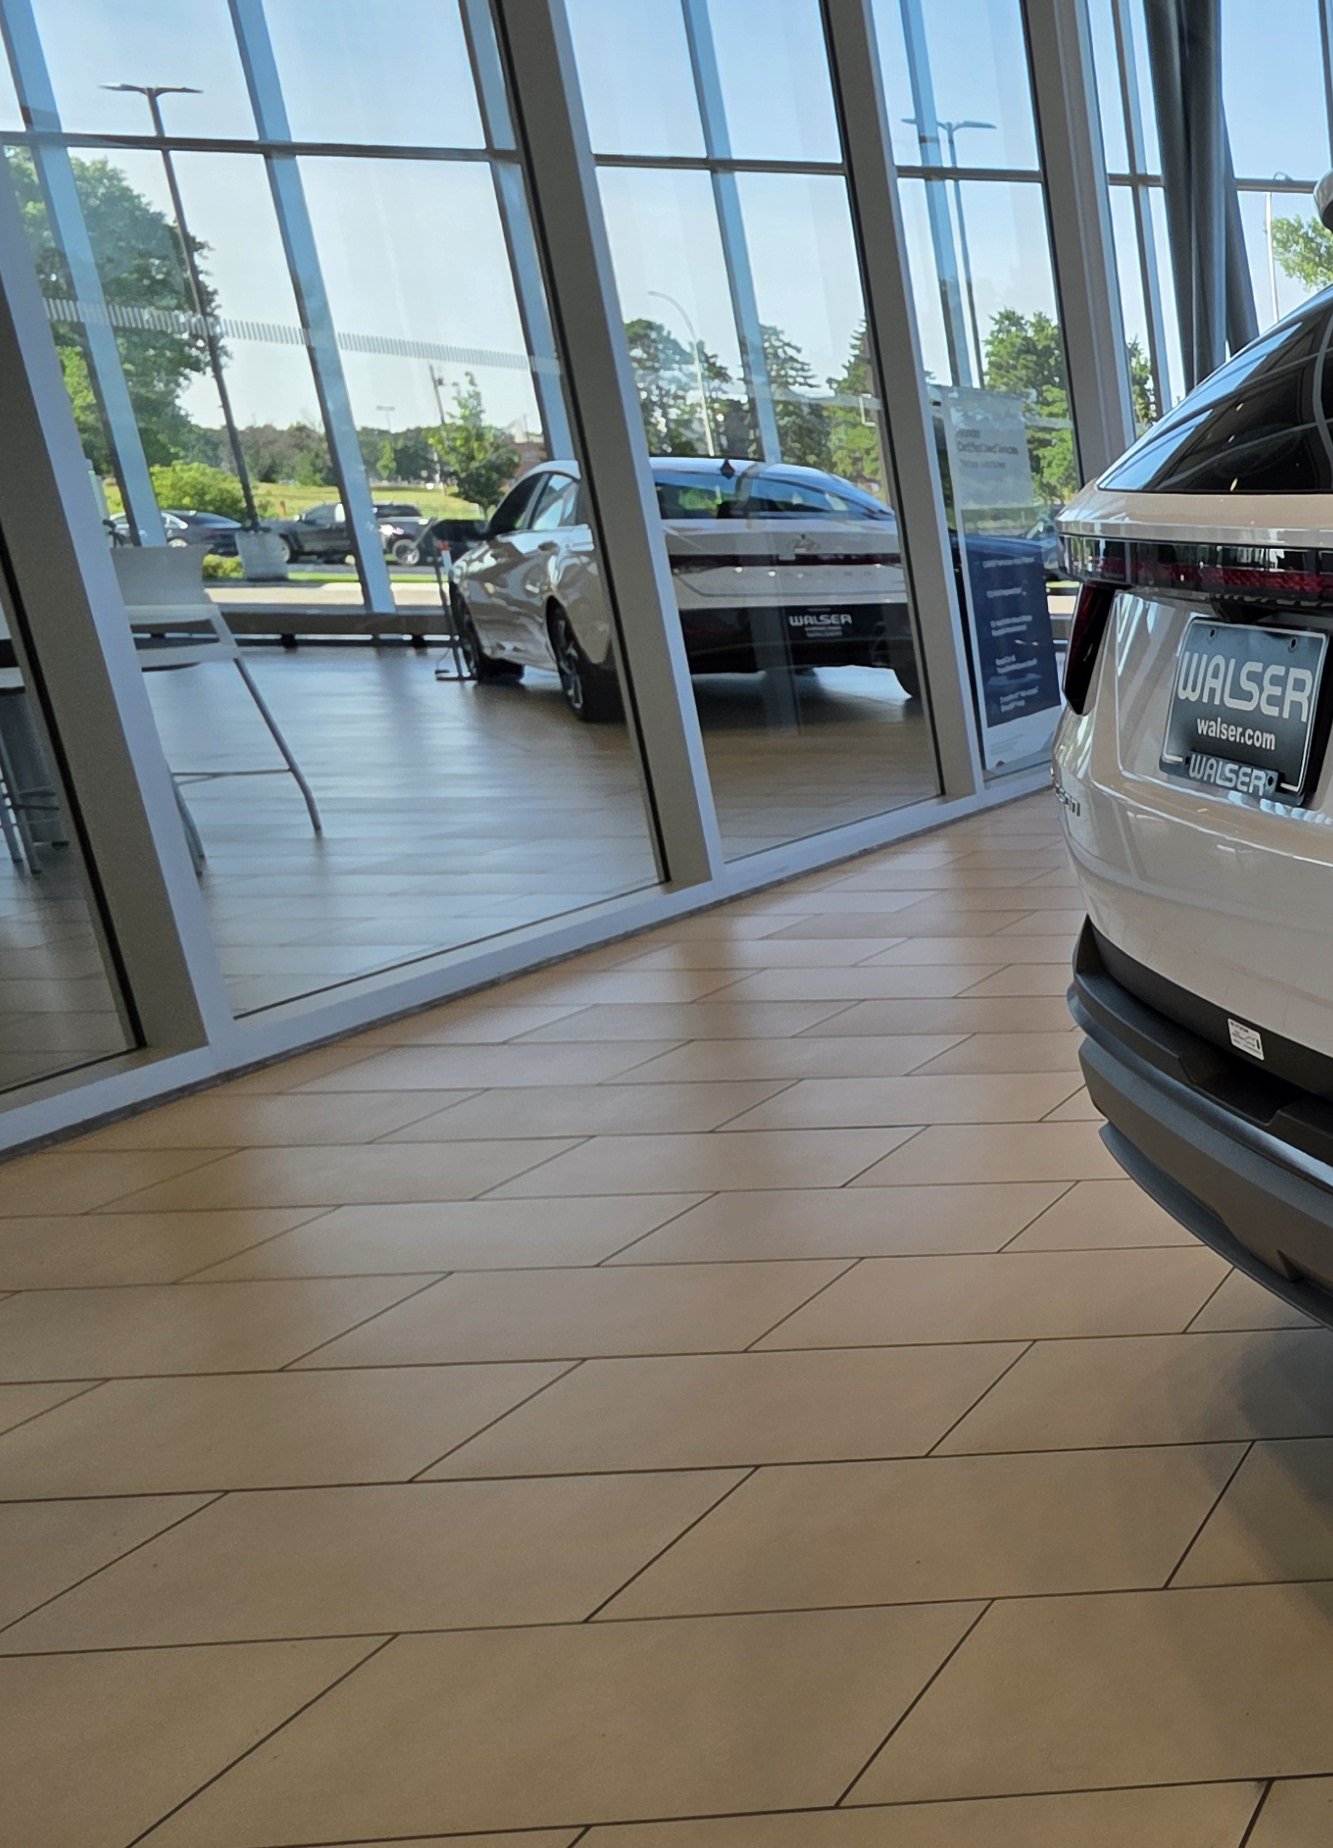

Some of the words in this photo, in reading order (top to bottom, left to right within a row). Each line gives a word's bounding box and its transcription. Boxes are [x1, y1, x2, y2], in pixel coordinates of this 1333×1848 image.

[789, 613, 853, 627] WALSER
[1177, 651, 1313, 723] WALSER
[1196, 717, 1276, 750] walser.com
[1188, 753, 1266, 797] WALSER
